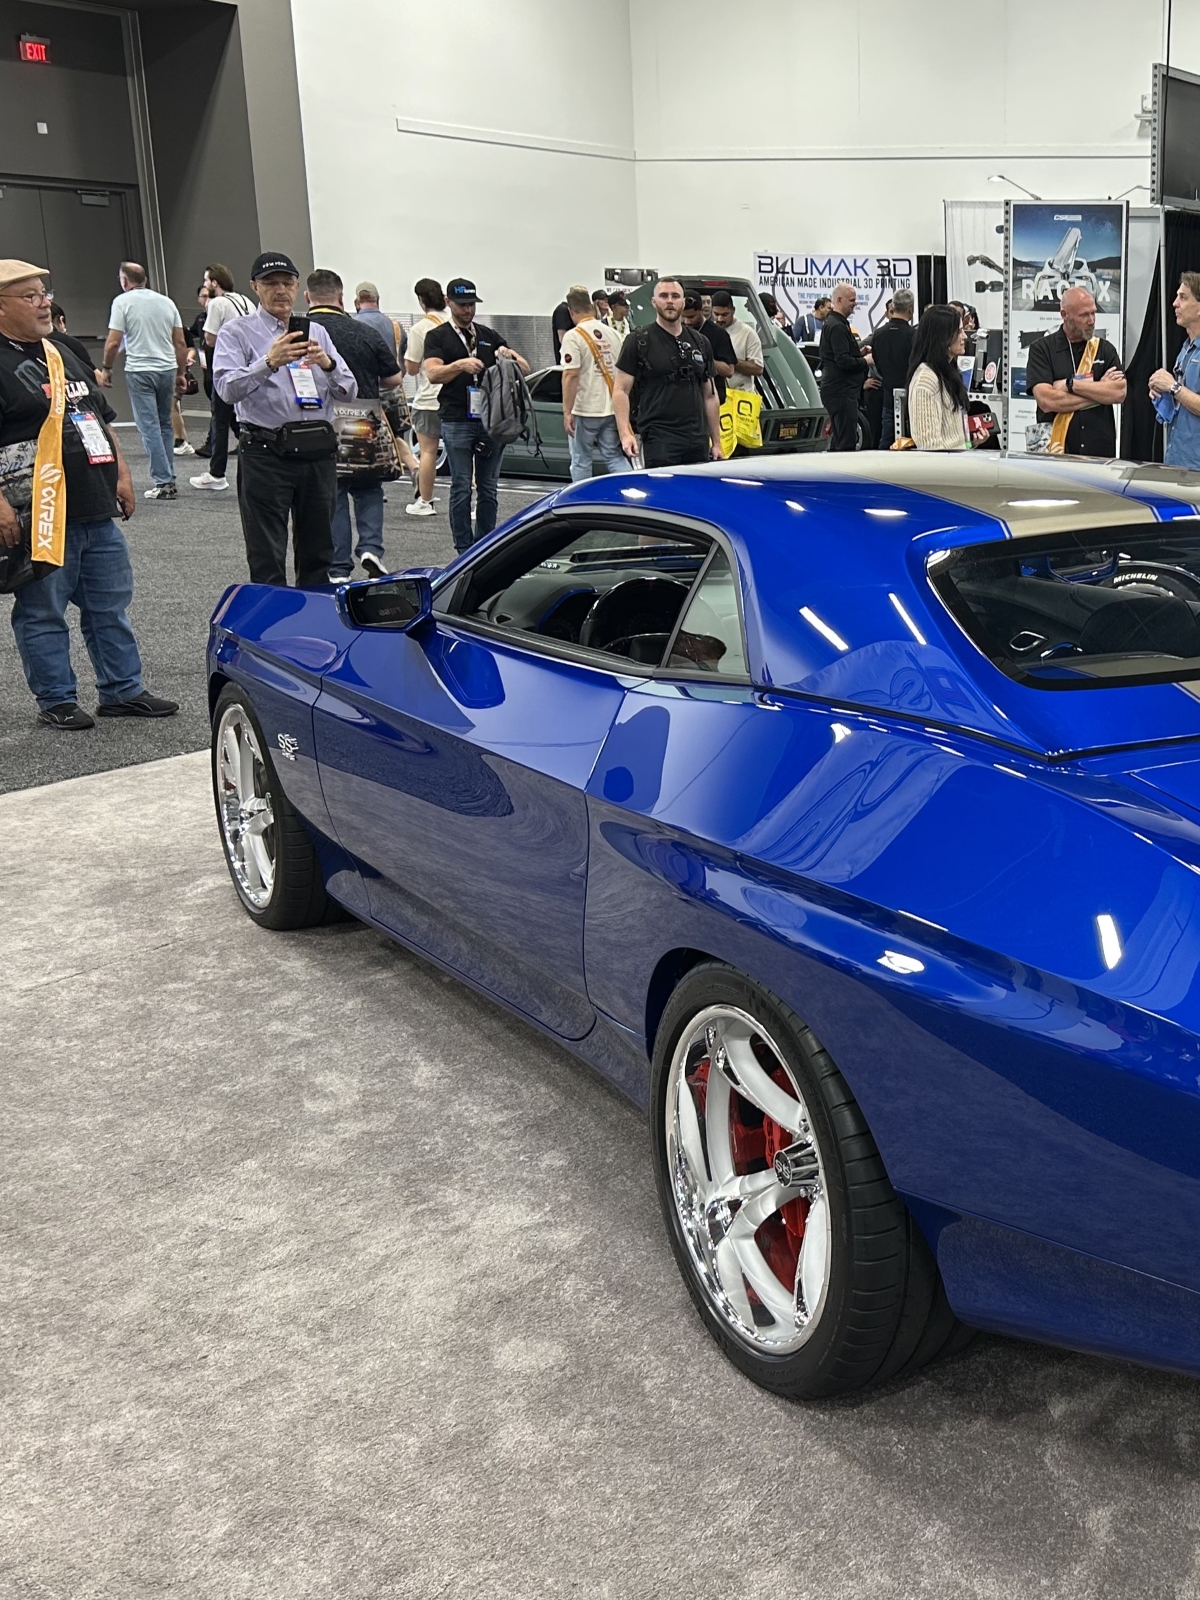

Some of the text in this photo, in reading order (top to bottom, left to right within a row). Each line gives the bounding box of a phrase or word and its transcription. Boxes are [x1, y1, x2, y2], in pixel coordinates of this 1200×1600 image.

[25, 42, 46, 60] EXIT
[757, 256, 912, 276] BLUMAK 3D
[759, 276, 795, 288] AMERICAN
[797, 277, 817, 288] MADE
[864, 278, 873, 289] 3D
[876, 278, 910, 289] PRINTING
[1098, 281, 1110, 301] X
[1113, 573, 1158, 584] MICHELIN
[776, 1159, 790, 1179] SS
